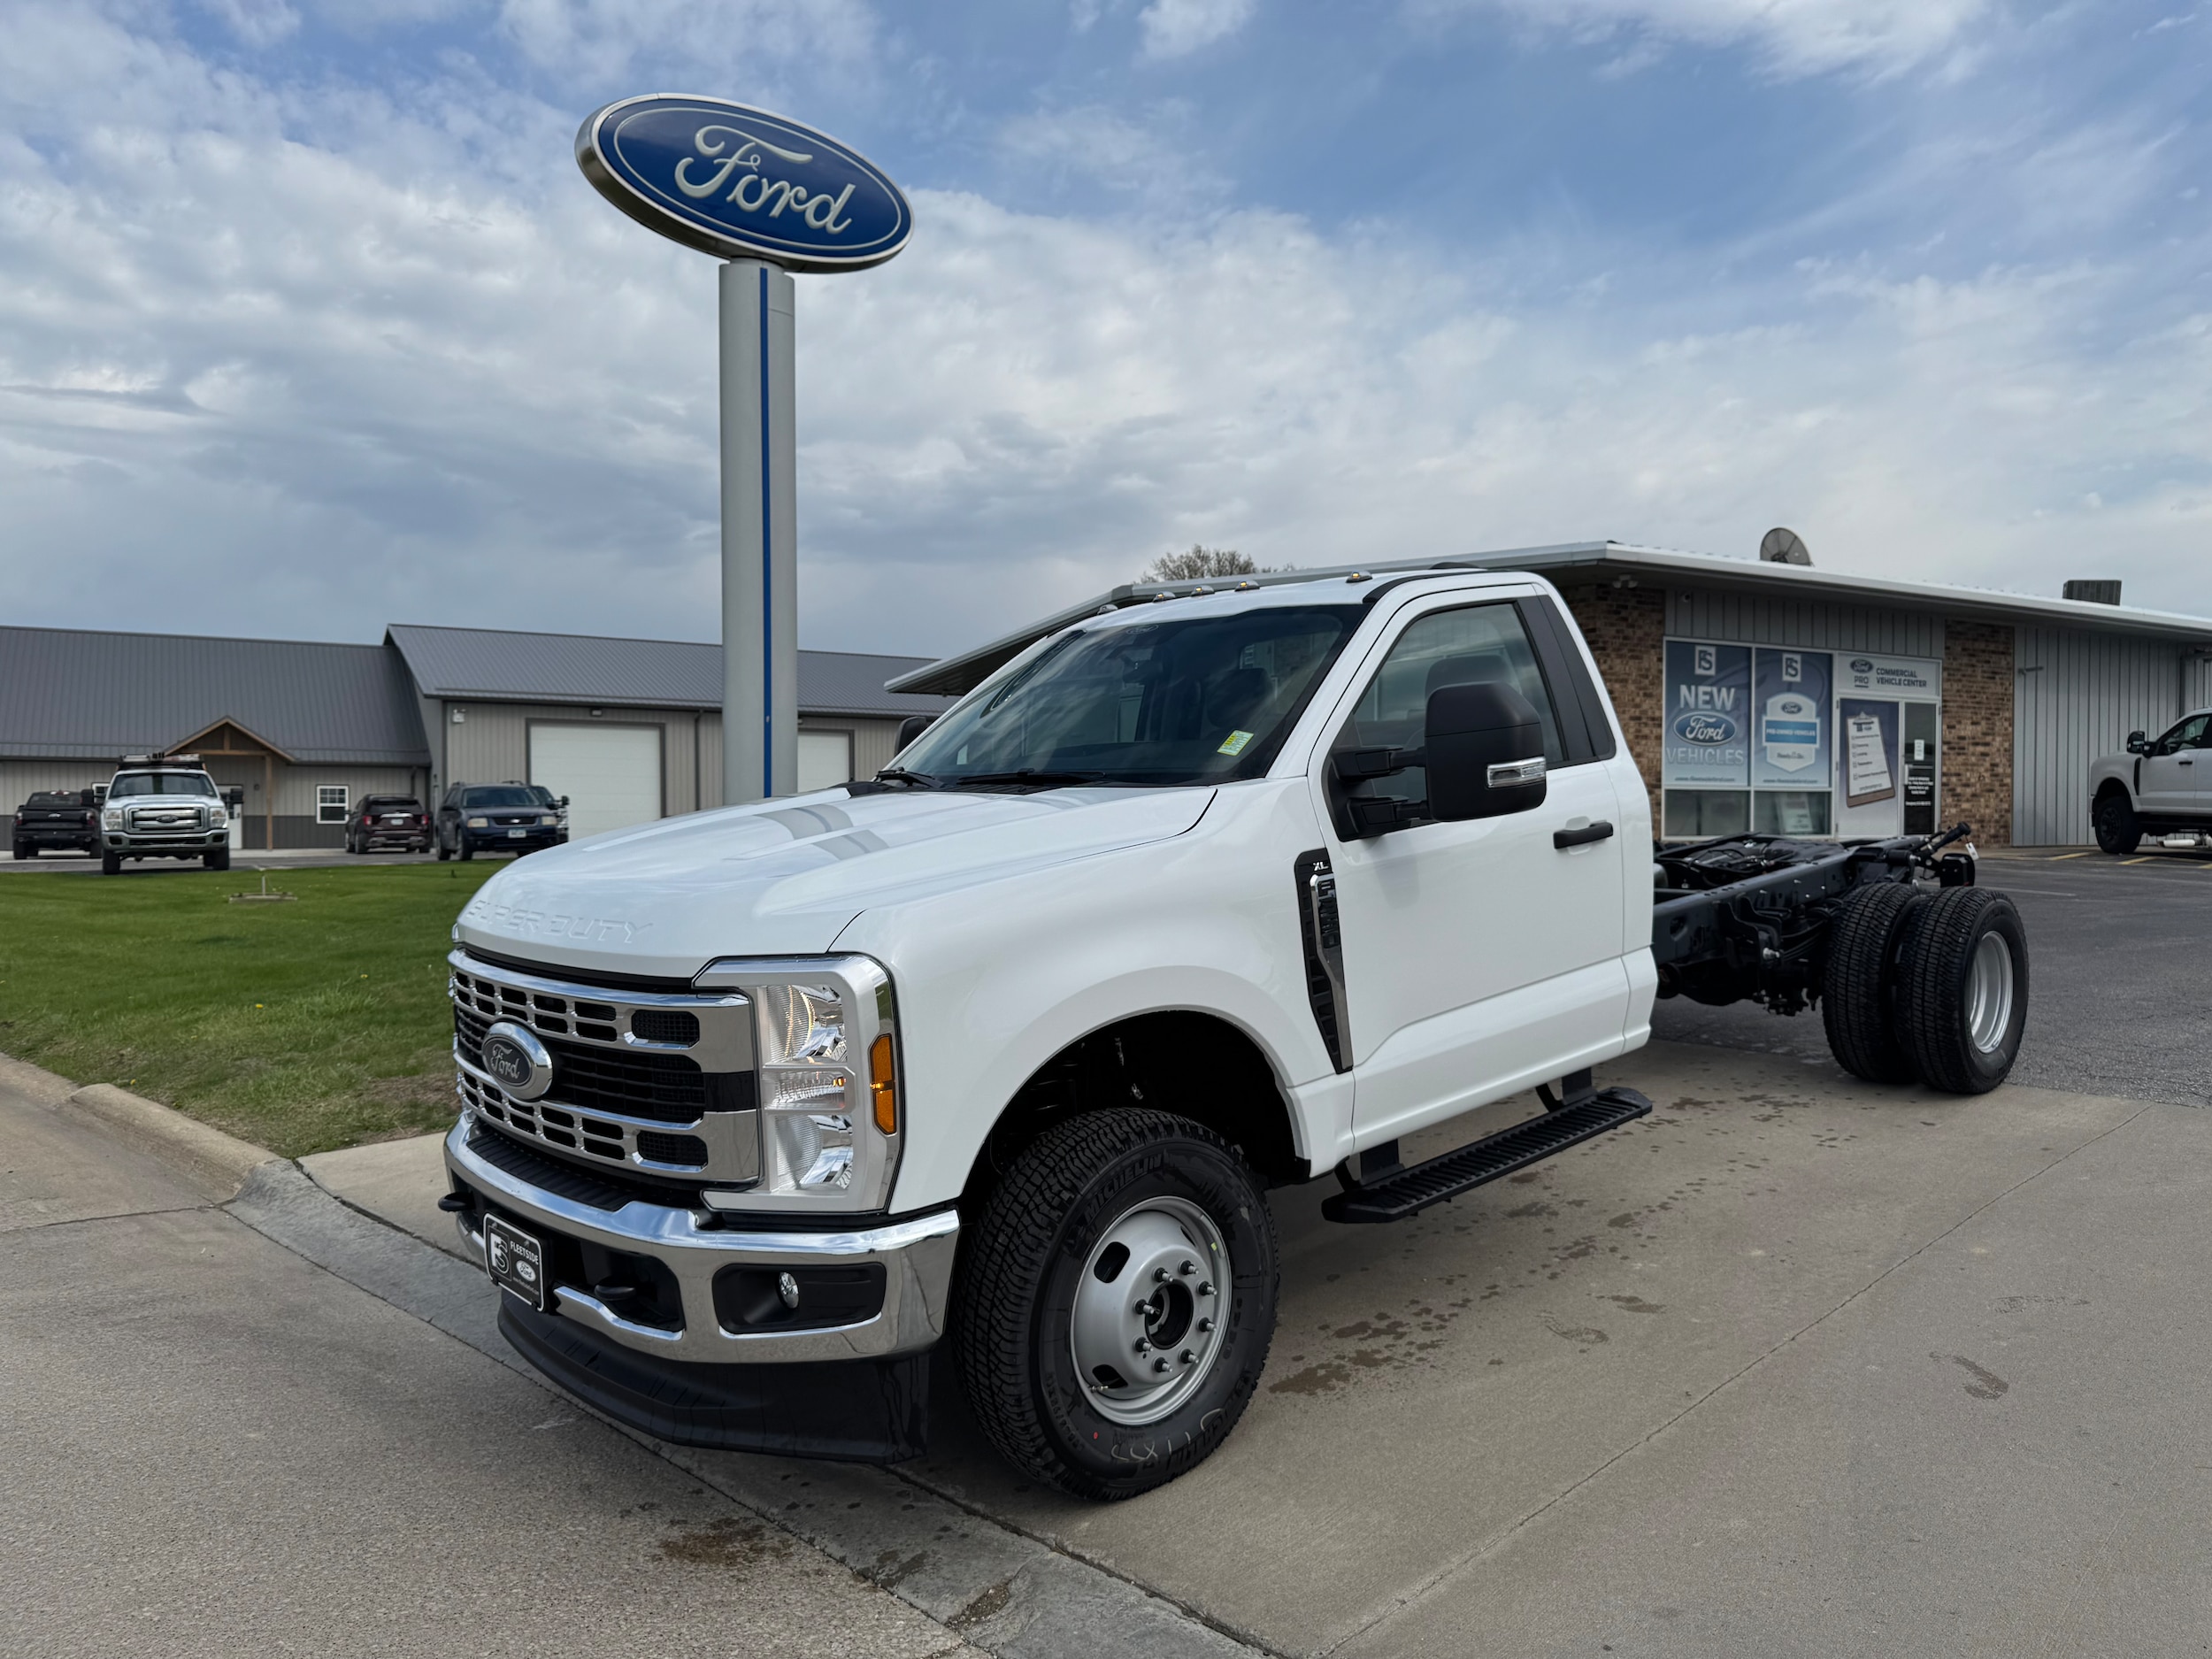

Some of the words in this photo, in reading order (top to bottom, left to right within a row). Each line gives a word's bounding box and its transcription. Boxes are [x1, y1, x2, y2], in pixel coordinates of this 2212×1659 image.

[674, 125, 856, 234] Ford
[1854, 675, 1869, 684] PRO
[1876, 667, 1918, 678] COMMERCIAL
[1876, 677, 1902, 687] VEHICLE
[1902, 679, 1927, 687] CENTER
[1679, 684, 1736, 711] NEW
[1685, 715, 1726, 741] Ford
[1666, 747, 1744, 766] VEHICLES
[1312, 861, 1329, 872] XL
[544, 914, 654, 944] DUTY
[490, 1043, 520, 1079] Ford
[1084, 1153, 1163, 1225] MICHELIN
[510, 1240, 540, 1265] FLEETSIDE
